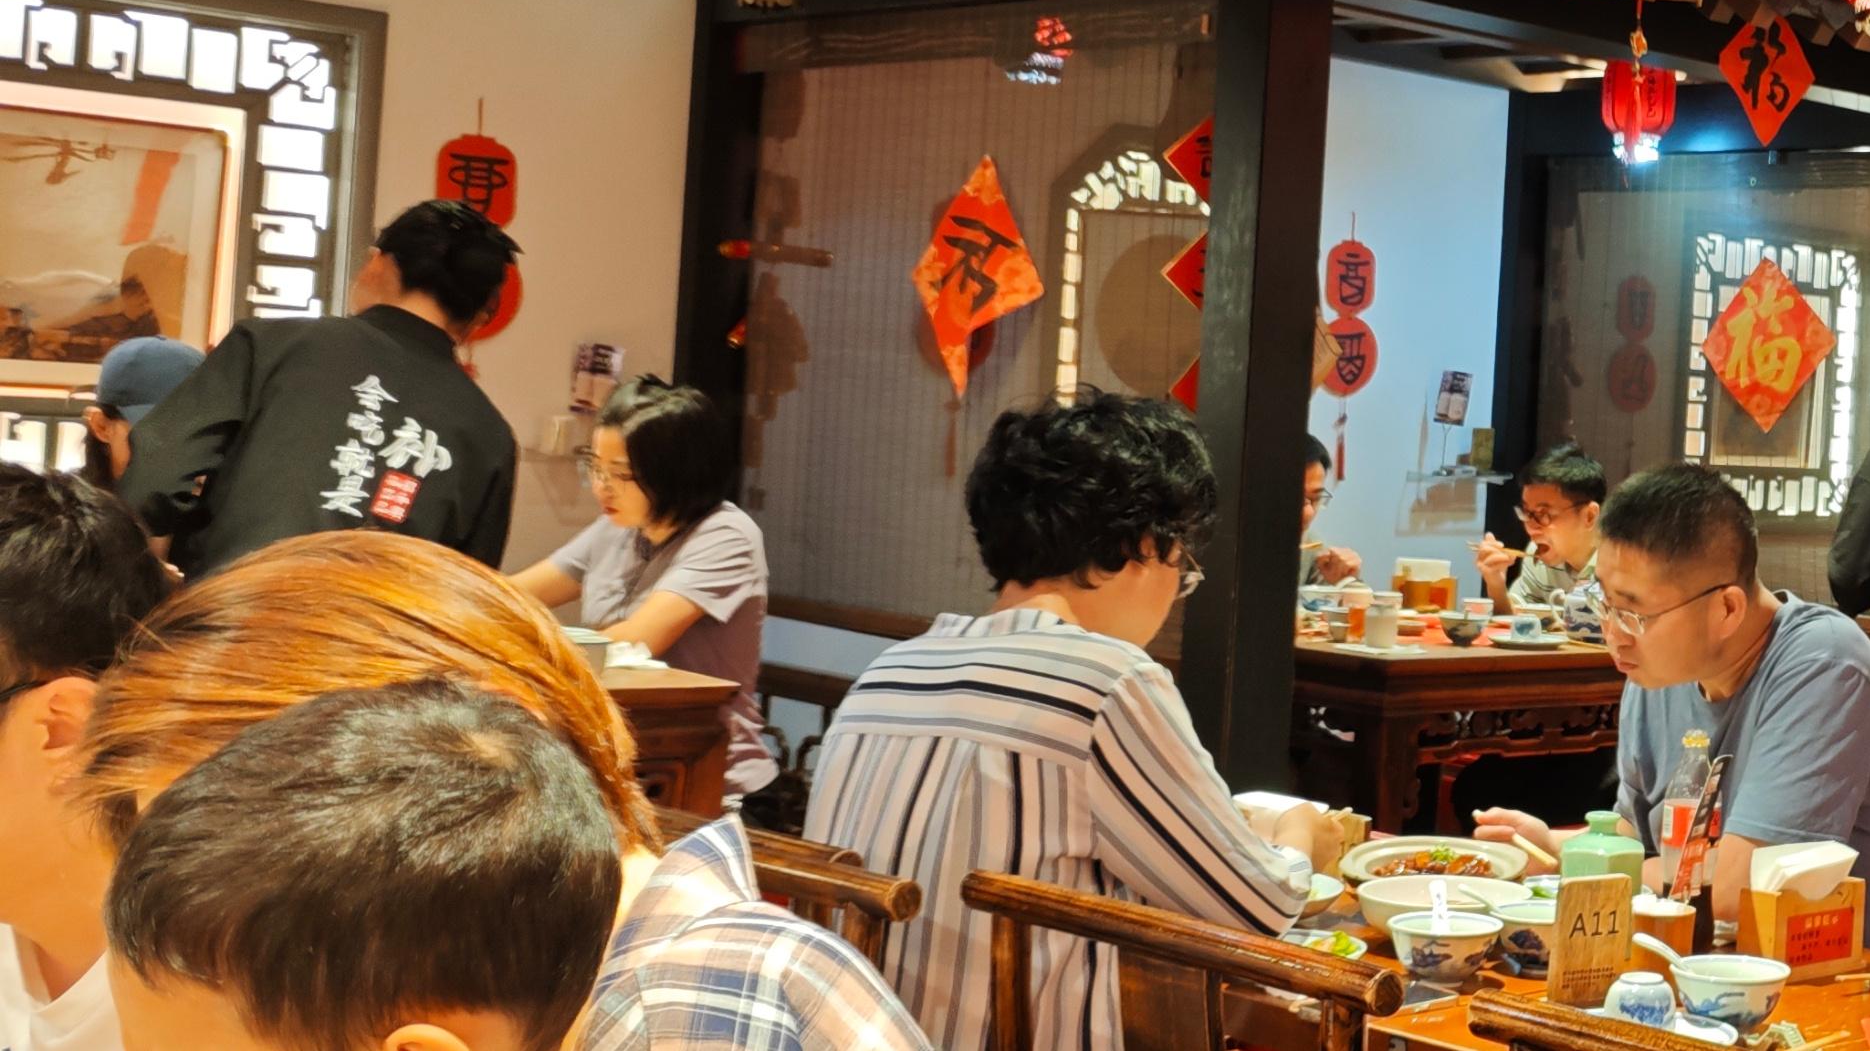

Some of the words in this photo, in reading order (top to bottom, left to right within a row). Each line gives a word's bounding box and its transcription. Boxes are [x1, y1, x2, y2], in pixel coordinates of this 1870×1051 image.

[1738, 21, 1791, 113] 福
[1725, 279, 1803, 394] 福
[1568, 909, 1620, 939] A11
